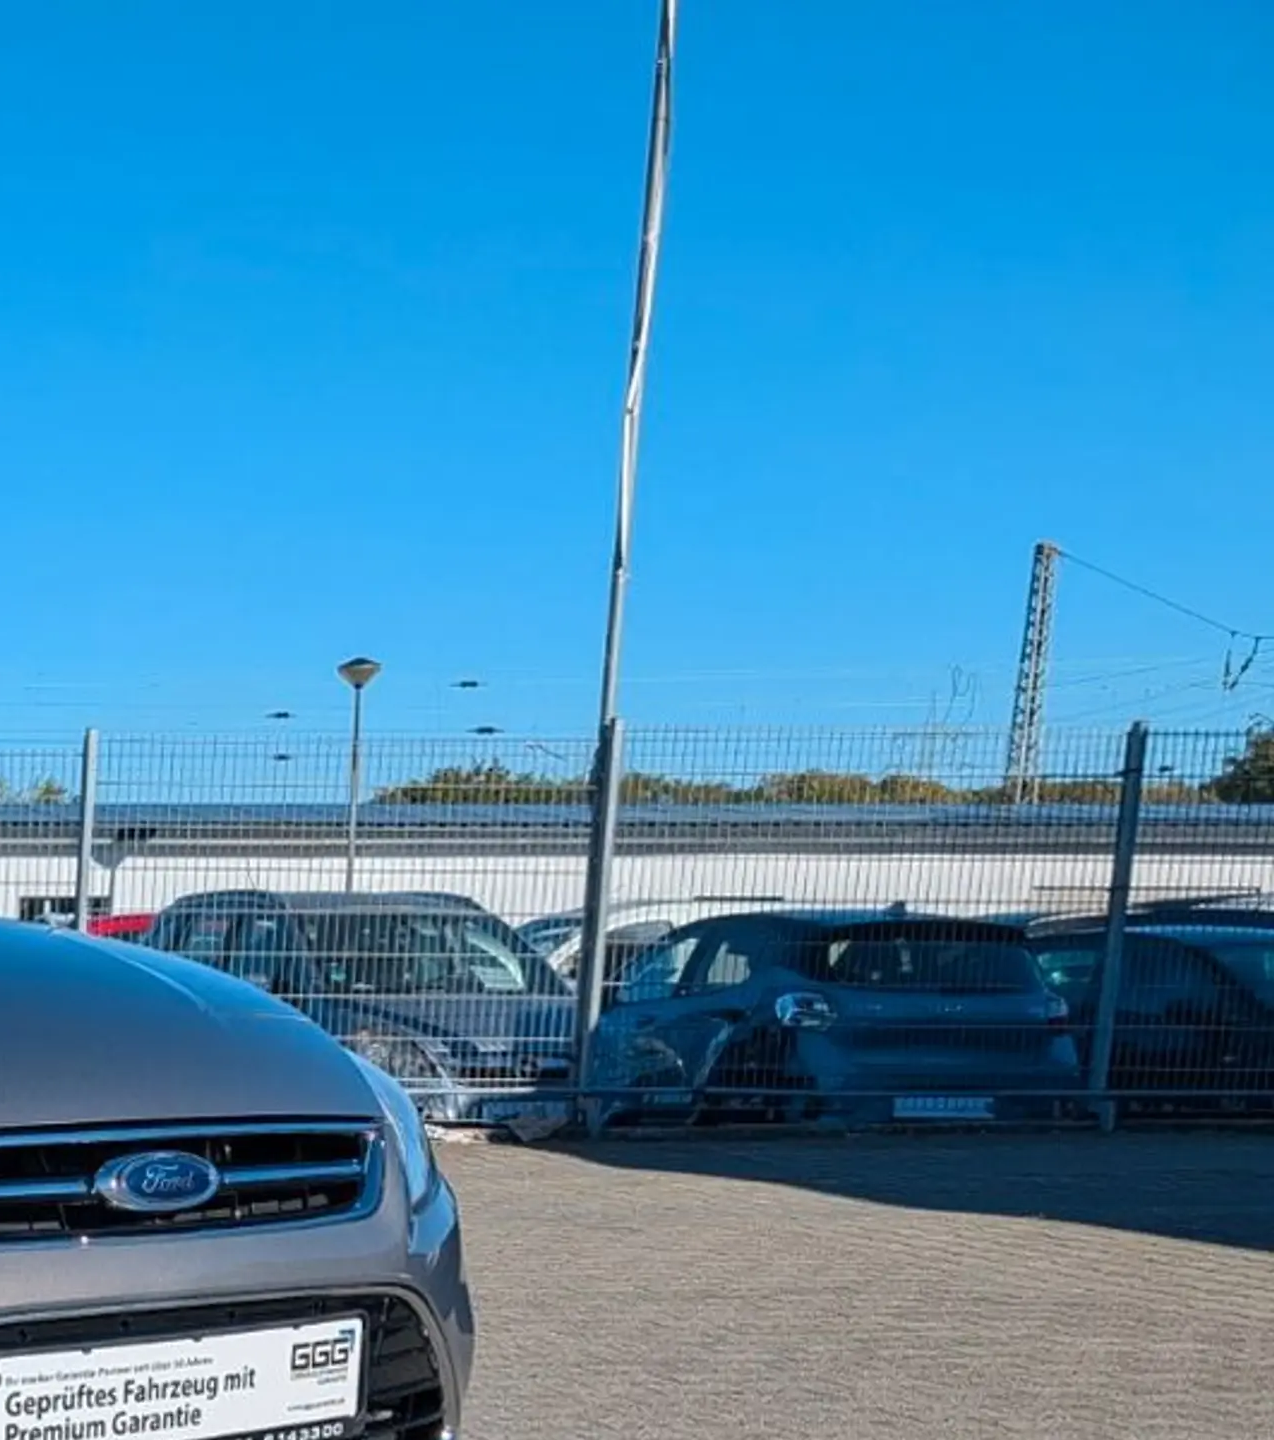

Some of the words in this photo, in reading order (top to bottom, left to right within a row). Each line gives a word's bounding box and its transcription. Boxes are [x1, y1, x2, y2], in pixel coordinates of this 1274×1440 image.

[141, 1164, 195, 1194] Ford
[291, 1337, 349, 1371] GGG
[5, 1384, 118, 1420] Geprüftes
[123, 1377, 219, 1404] Fahrzeug
[223, 1366, 257, 1392] mit
[111, 1403, 202, 1436] Garantie
